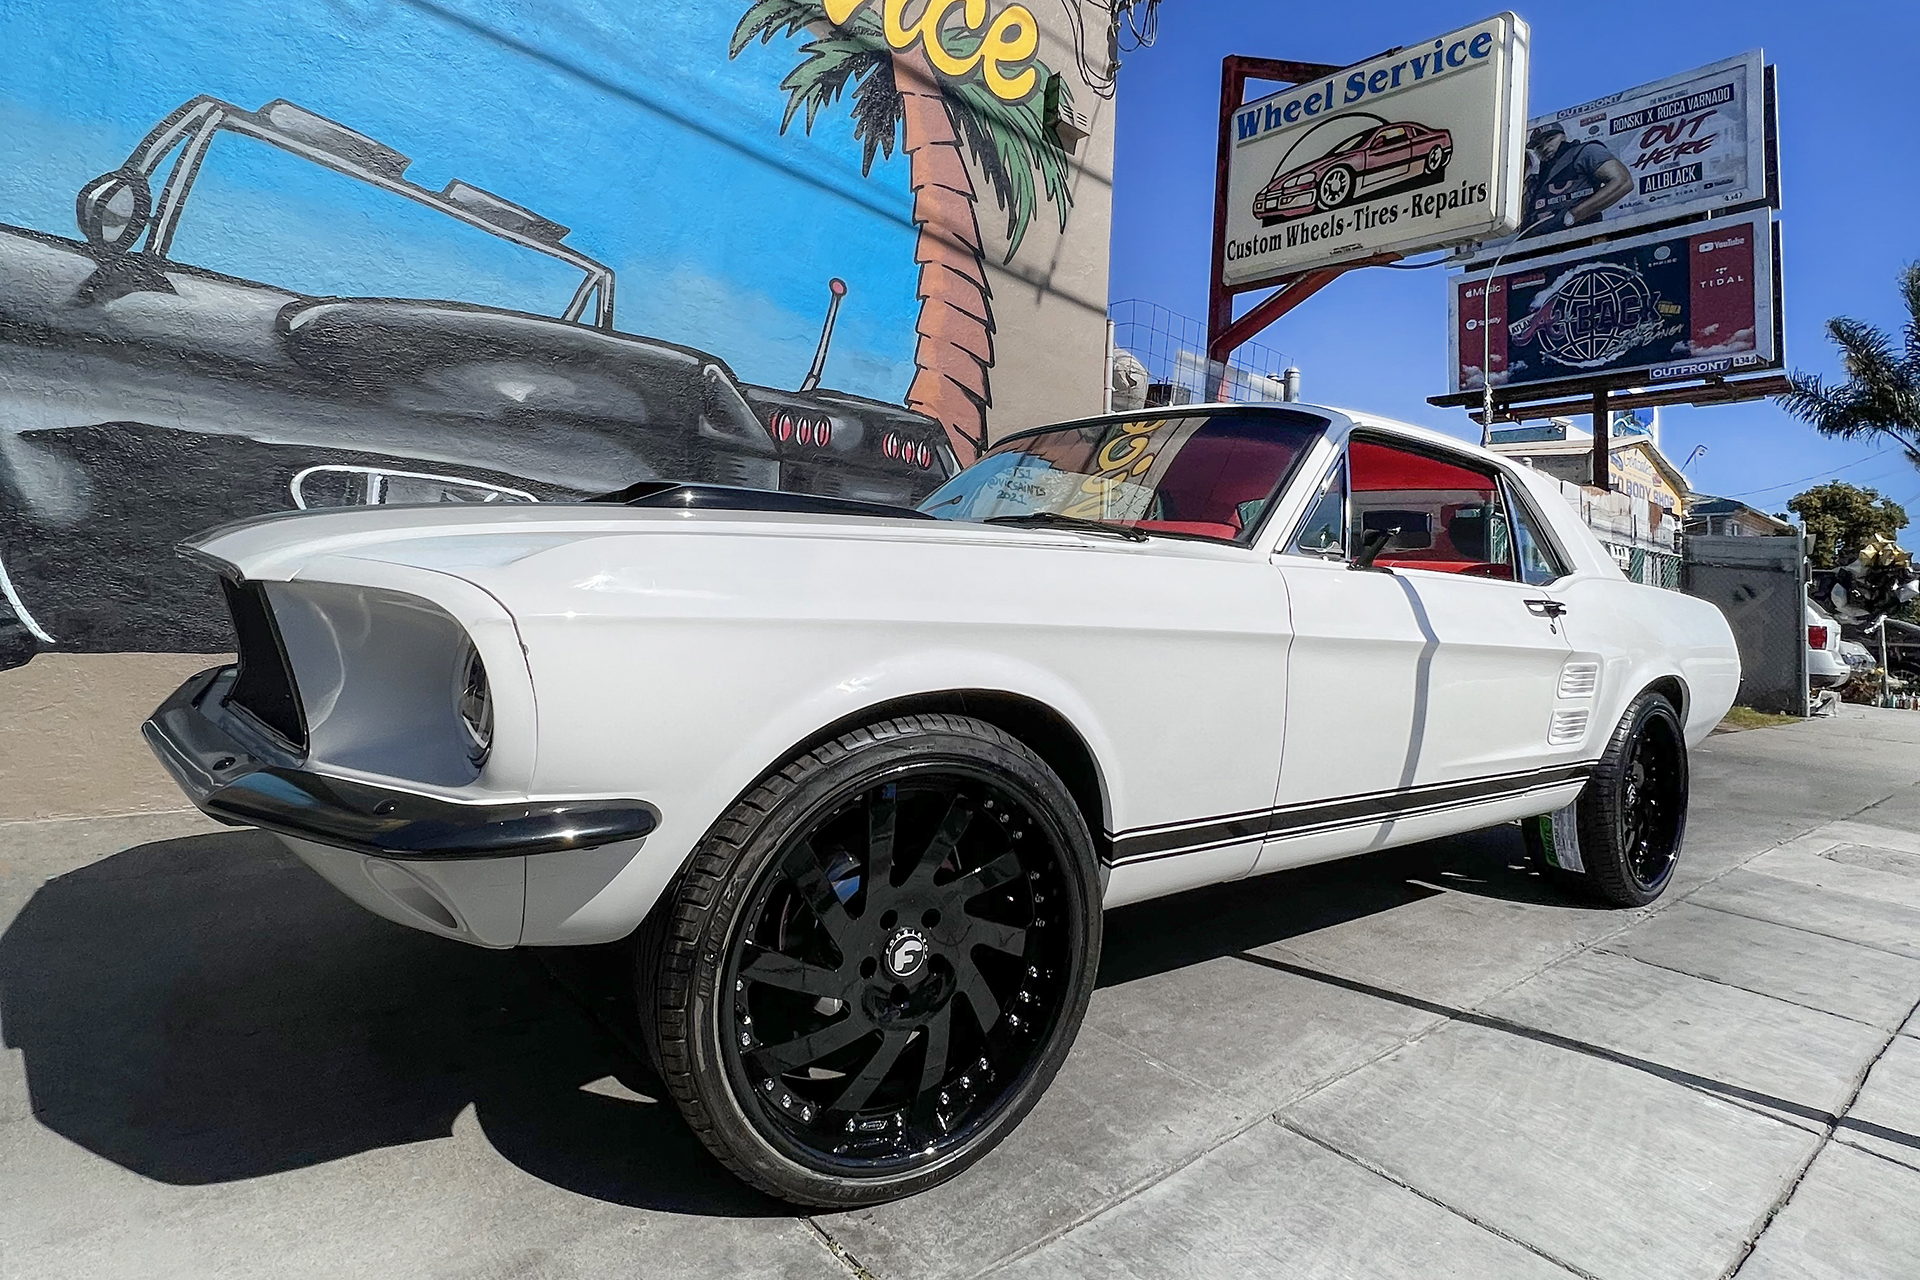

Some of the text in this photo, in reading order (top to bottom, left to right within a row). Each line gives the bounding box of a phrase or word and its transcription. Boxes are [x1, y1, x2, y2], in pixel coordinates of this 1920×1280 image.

[1237, 31, 1493, 140] Wheel Service
[1613, 113, 1643, 132] RONSKI
[1646, 108, 1654, 123] X
[1657, 101, 1685, 120] ROCCA
[1687, 86, 1730, 111] VARNADO
[1640, 110, 1717, 149] OUT
[1630, 133, 1717, 170] HERE
[1645, 166, 1696, 192] ALLBLACK
[1226, 233, 1282, 261] Custom
[1286, 218, 1344, 246] Wheels
[1411, 180, 1488, 219] Repairs
[1700, 275, 1744, 288] TIDAL
[1652, 360, 1728, 377] OUTFRONT
[996, 490, 1027, 505] 2021
[1626, 480, 1651, 500] BODY
[1653, 490, 1675, 506] SHOP
